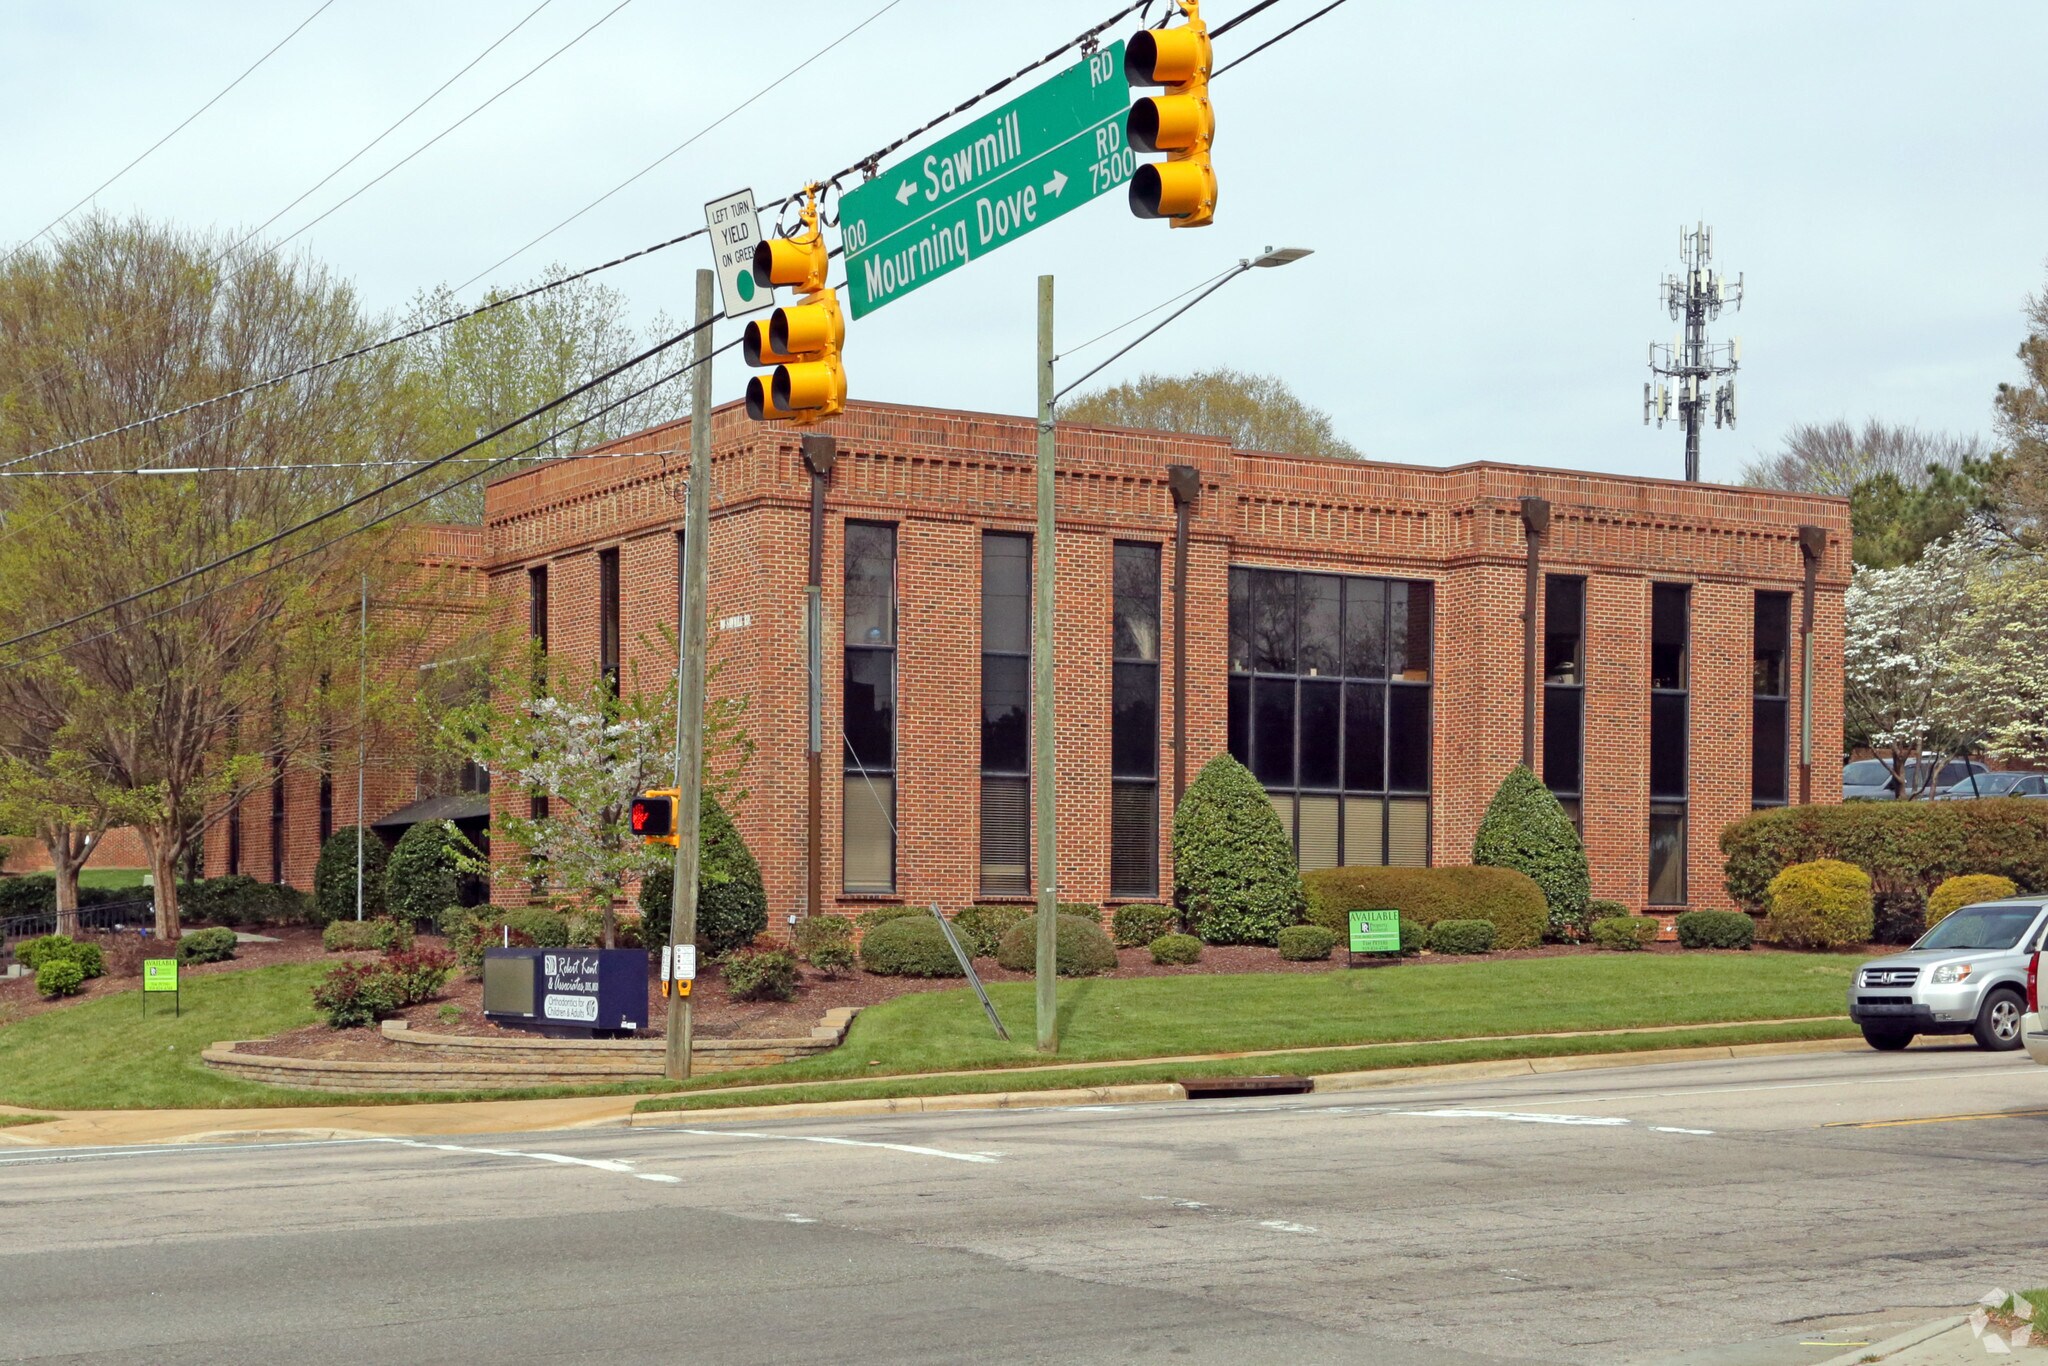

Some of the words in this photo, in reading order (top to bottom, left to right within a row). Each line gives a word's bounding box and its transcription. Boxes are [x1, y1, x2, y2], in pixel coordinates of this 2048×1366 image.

[923, 109, 1021, 202] Sawmill
[1089, 51, 1113, 88] RD
[1096, 121, 1120, 159] RD
[1088, 146, 1134, 194] 7500
[711, 207, 729, 225] LEFT
[731, 200, 750, 217] TURN
[721, 222, 749, 246] YIELD
[843, 219, 867, 255] 100
[864, 219, 970, 303] Mourning
[976, 185, 1037, 246] Dove
[722, 252, 733, 268] ON
[1350, 912, 1398, 921] AVAILABLE
[559, 956, 580, 977] Robert
[581, 956, 599, 975] Kent
[548, 976, 554, 990] &
[548, 1006, 566, 1016] Children
[570, 1008, 585, 1019] Adults
[549, 996, 578, 1007] Orthodontics
